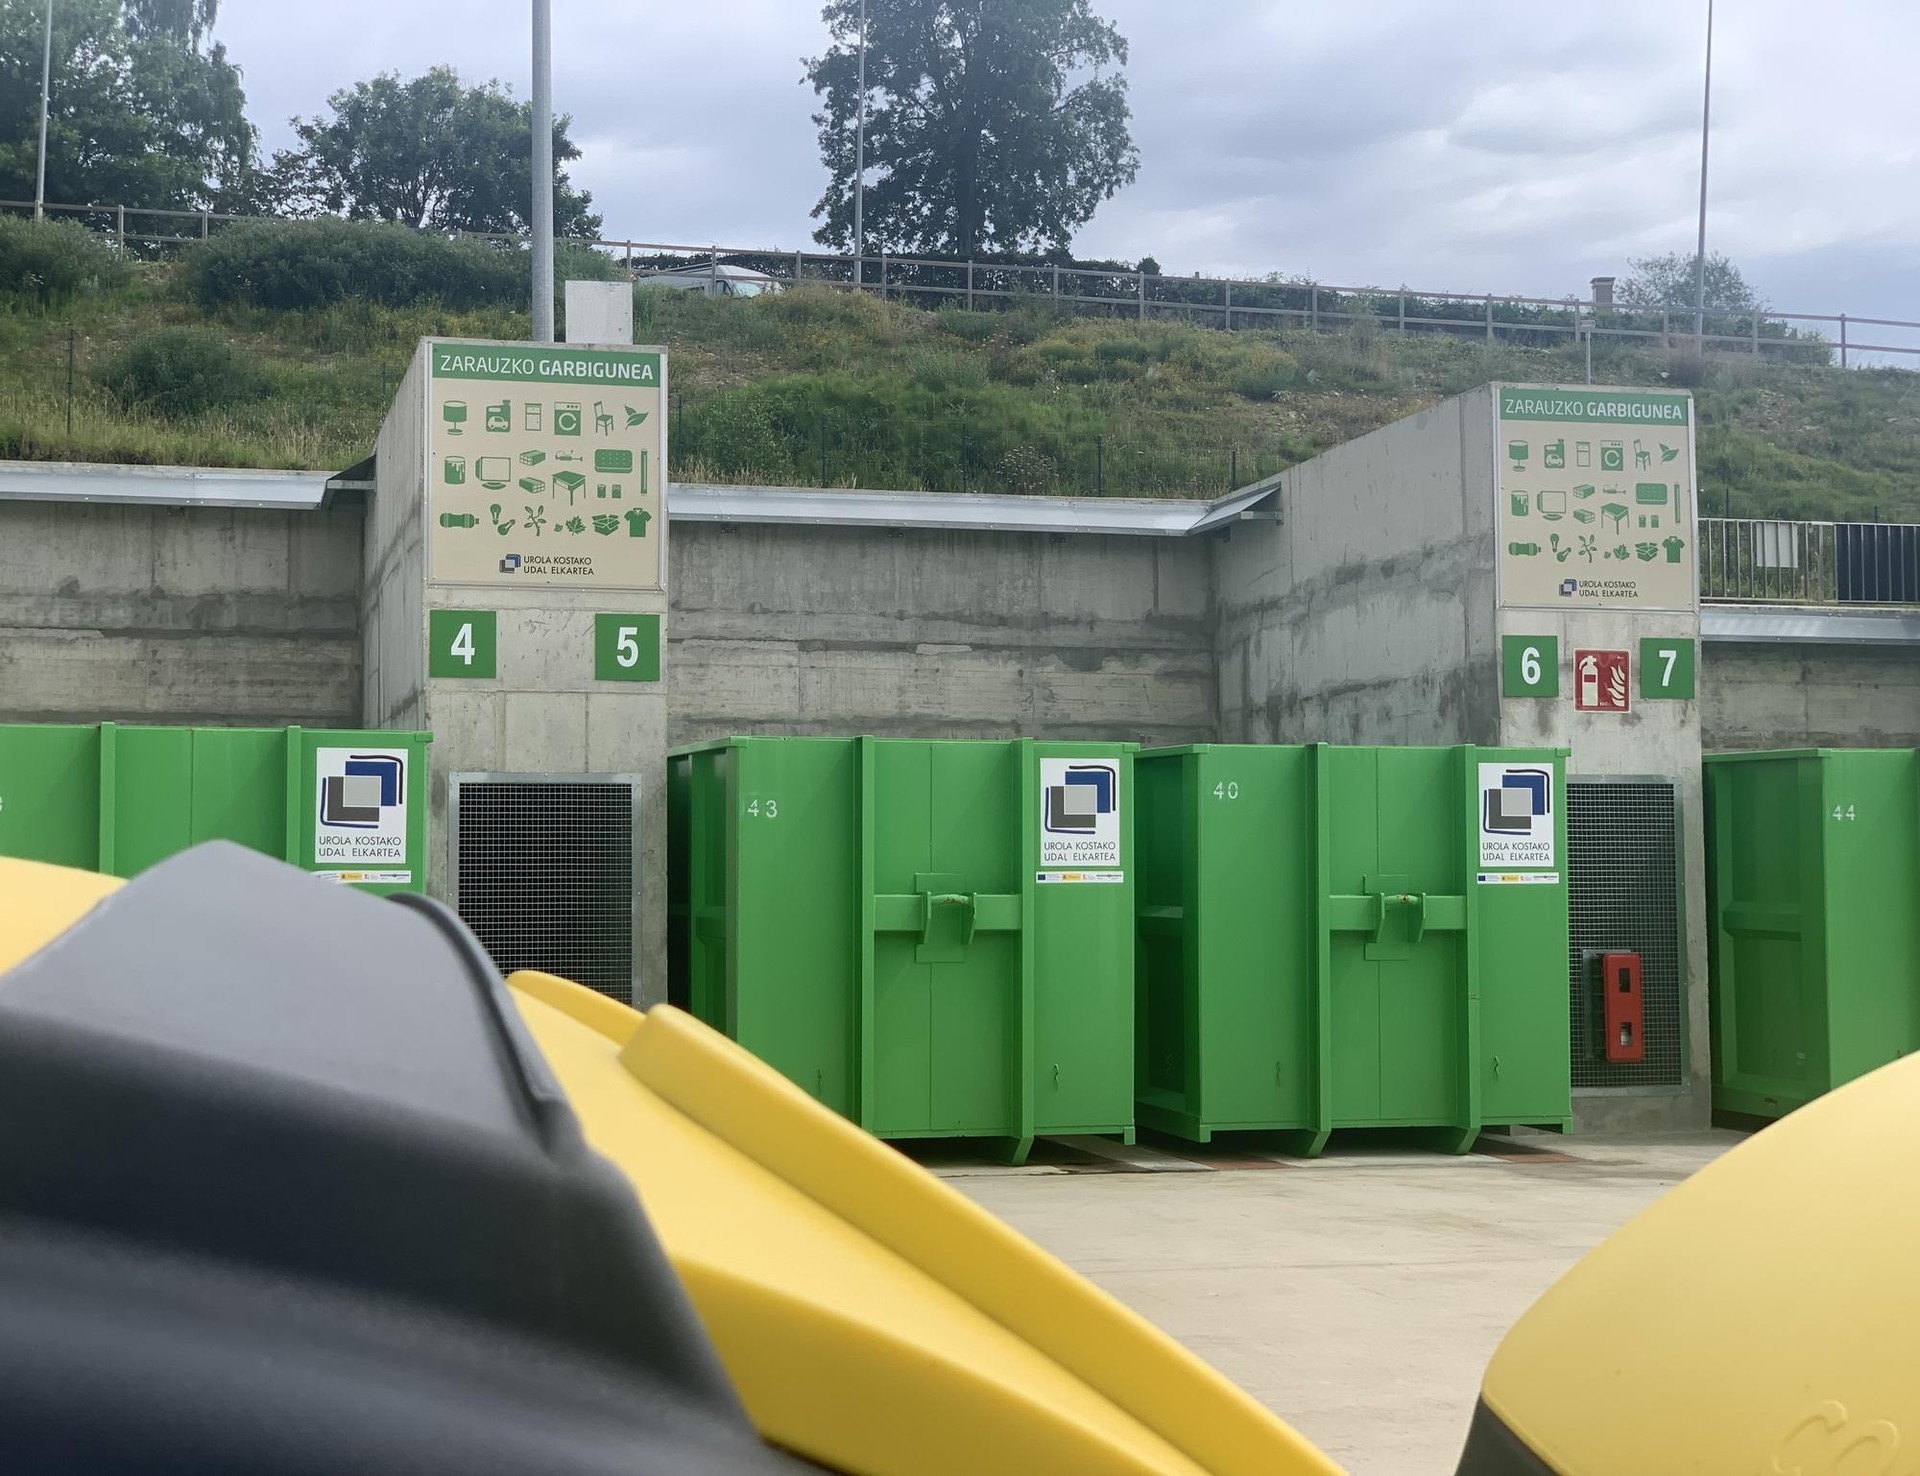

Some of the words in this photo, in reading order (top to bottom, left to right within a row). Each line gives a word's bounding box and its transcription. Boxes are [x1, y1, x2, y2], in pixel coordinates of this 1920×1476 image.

[440, 355, 534, 375] ZARAUZKO
[539, 360, 653, 380] GARBIGUNEA
[1505, 399, 1583, 417] ZARAUZKO
[1587, 402, 1682, 420] GARBIGUNEA
[523, 556, 551, 566] UROLA
[553, 557, 592, 566] KOSTAKO
[523, 566, 547, 575] UDAL
[551, 566, 594, 576] ELKARTEA
[1579, 580, 1602, 589] UROLA
[1603, 580, 1636, 589] KOSTAKO
[1579, 589, 1600, 598] UDAL
[1602, 589, 1638, 598] ELKARTEA
[450, 623, 475, 665] 4
[616, 627, 639, 668] 5
[1521, 647, 1541, 685] 6
[1658, 650, 1677, 687] 7
[1213, 781, 1239, 800] 40
[747, 799, 778, 818] 43
[1832, 804, 1856, 821] 44
[319, 836, 351, 846] UROLA
[355, 836, 401, 846] KOSTAKO
[1045, 842, 1072, 851] UROLA
[1075, 842, 1115, 851] KOSTAKO
[1482, 842, 1509, 851] UROLA
[1512, 842, 1550, 851] KOSTAKO
[319, 847, 346, 857] UDAL
[352, 848, 401, 858] ELKARTEA
[1044, 852, 1068, 861] UDAL
[1073, 852, 1116, 861] ELKARTEA
[1482, 852, 1505, 861] UDAL
[1510, 852, 1550, 861] ELKARTEA
